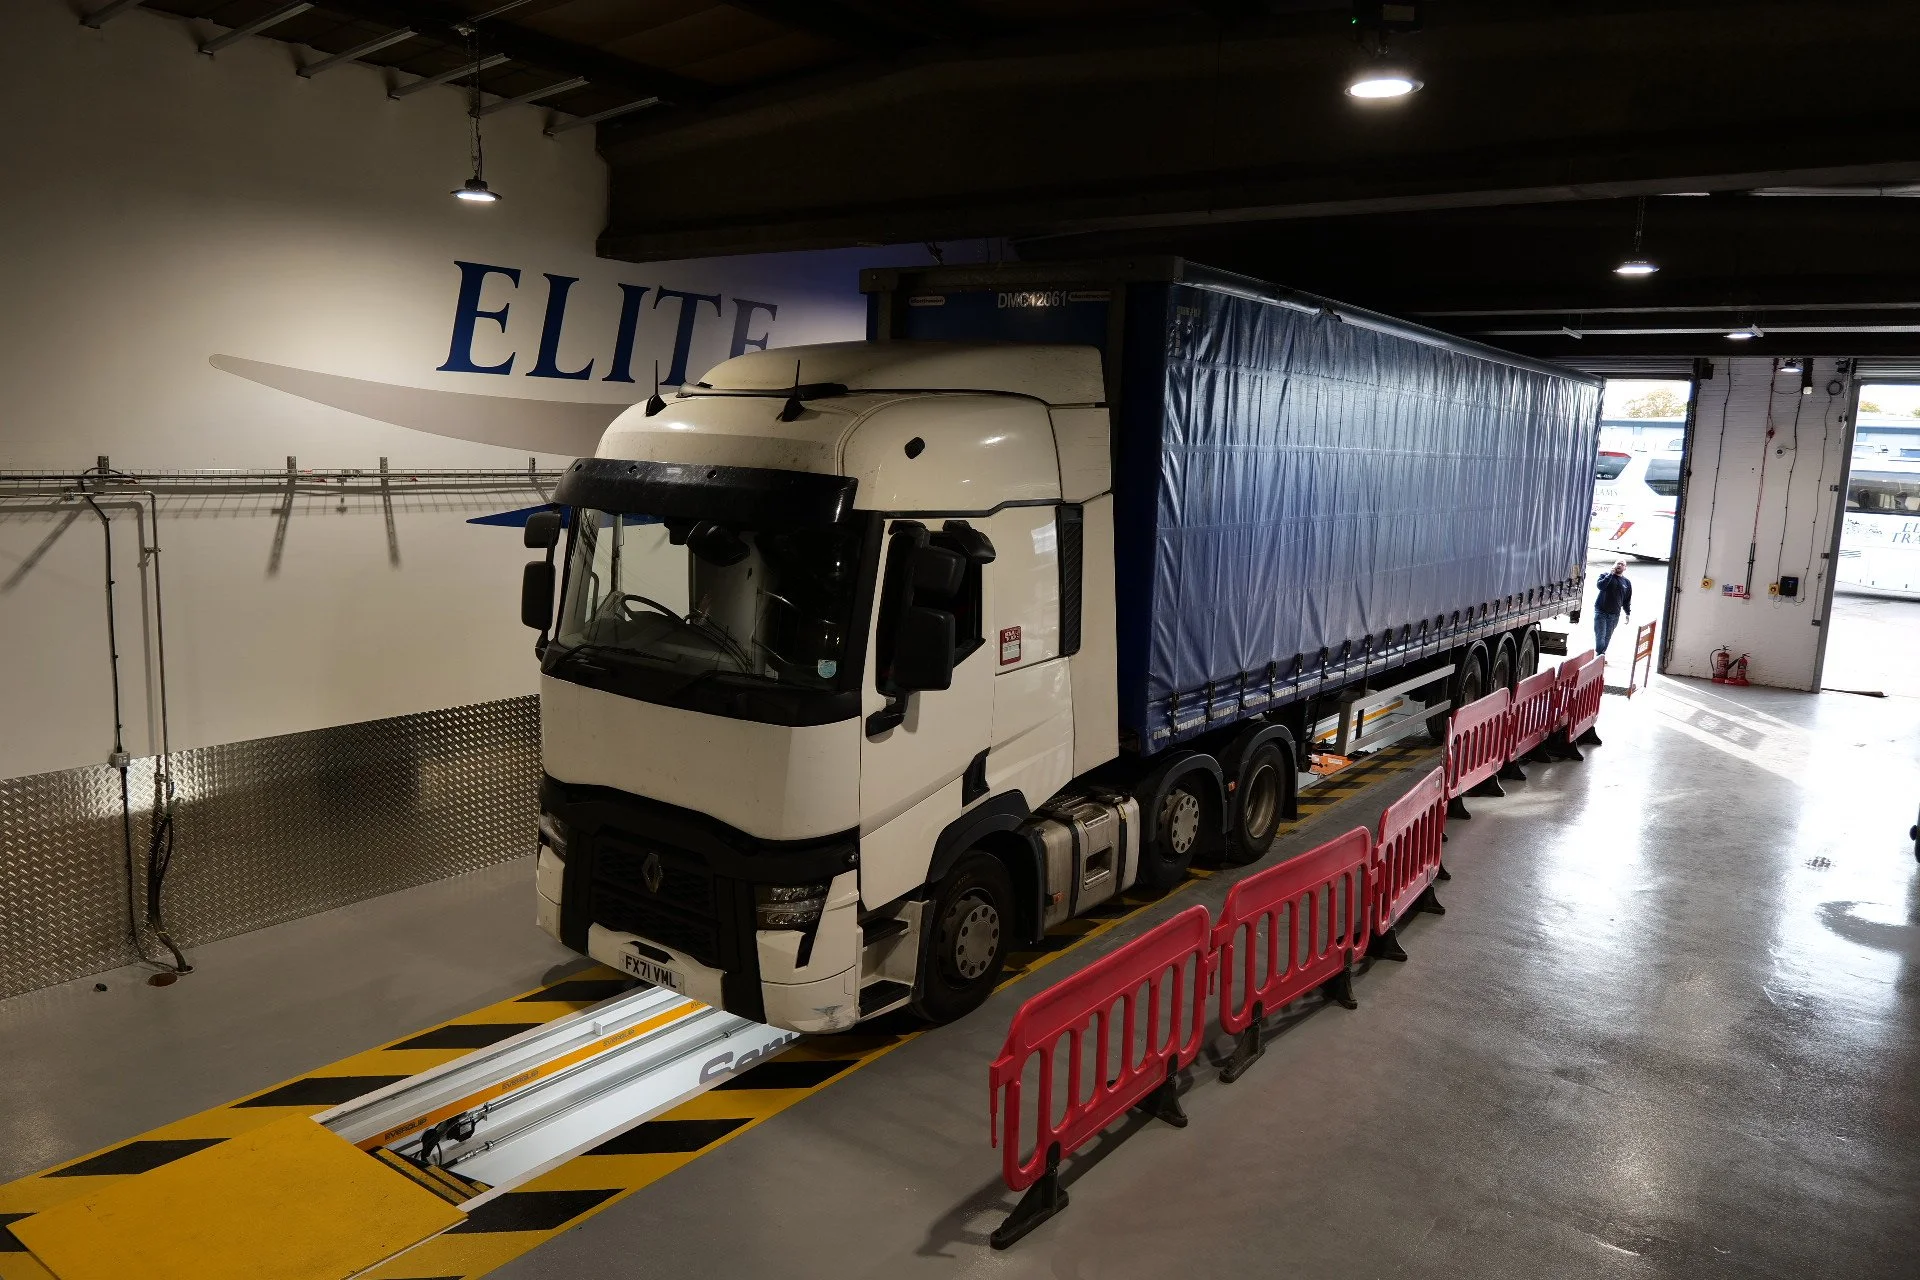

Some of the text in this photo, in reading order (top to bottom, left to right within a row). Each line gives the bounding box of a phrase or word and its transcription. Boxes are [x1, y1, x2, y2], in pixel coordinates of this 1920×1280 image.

[997, 291, 1067, 308] DMC12061
[436, 261, 778, 386] ELITE
[625, 954, 676, 989] FX71 VML
